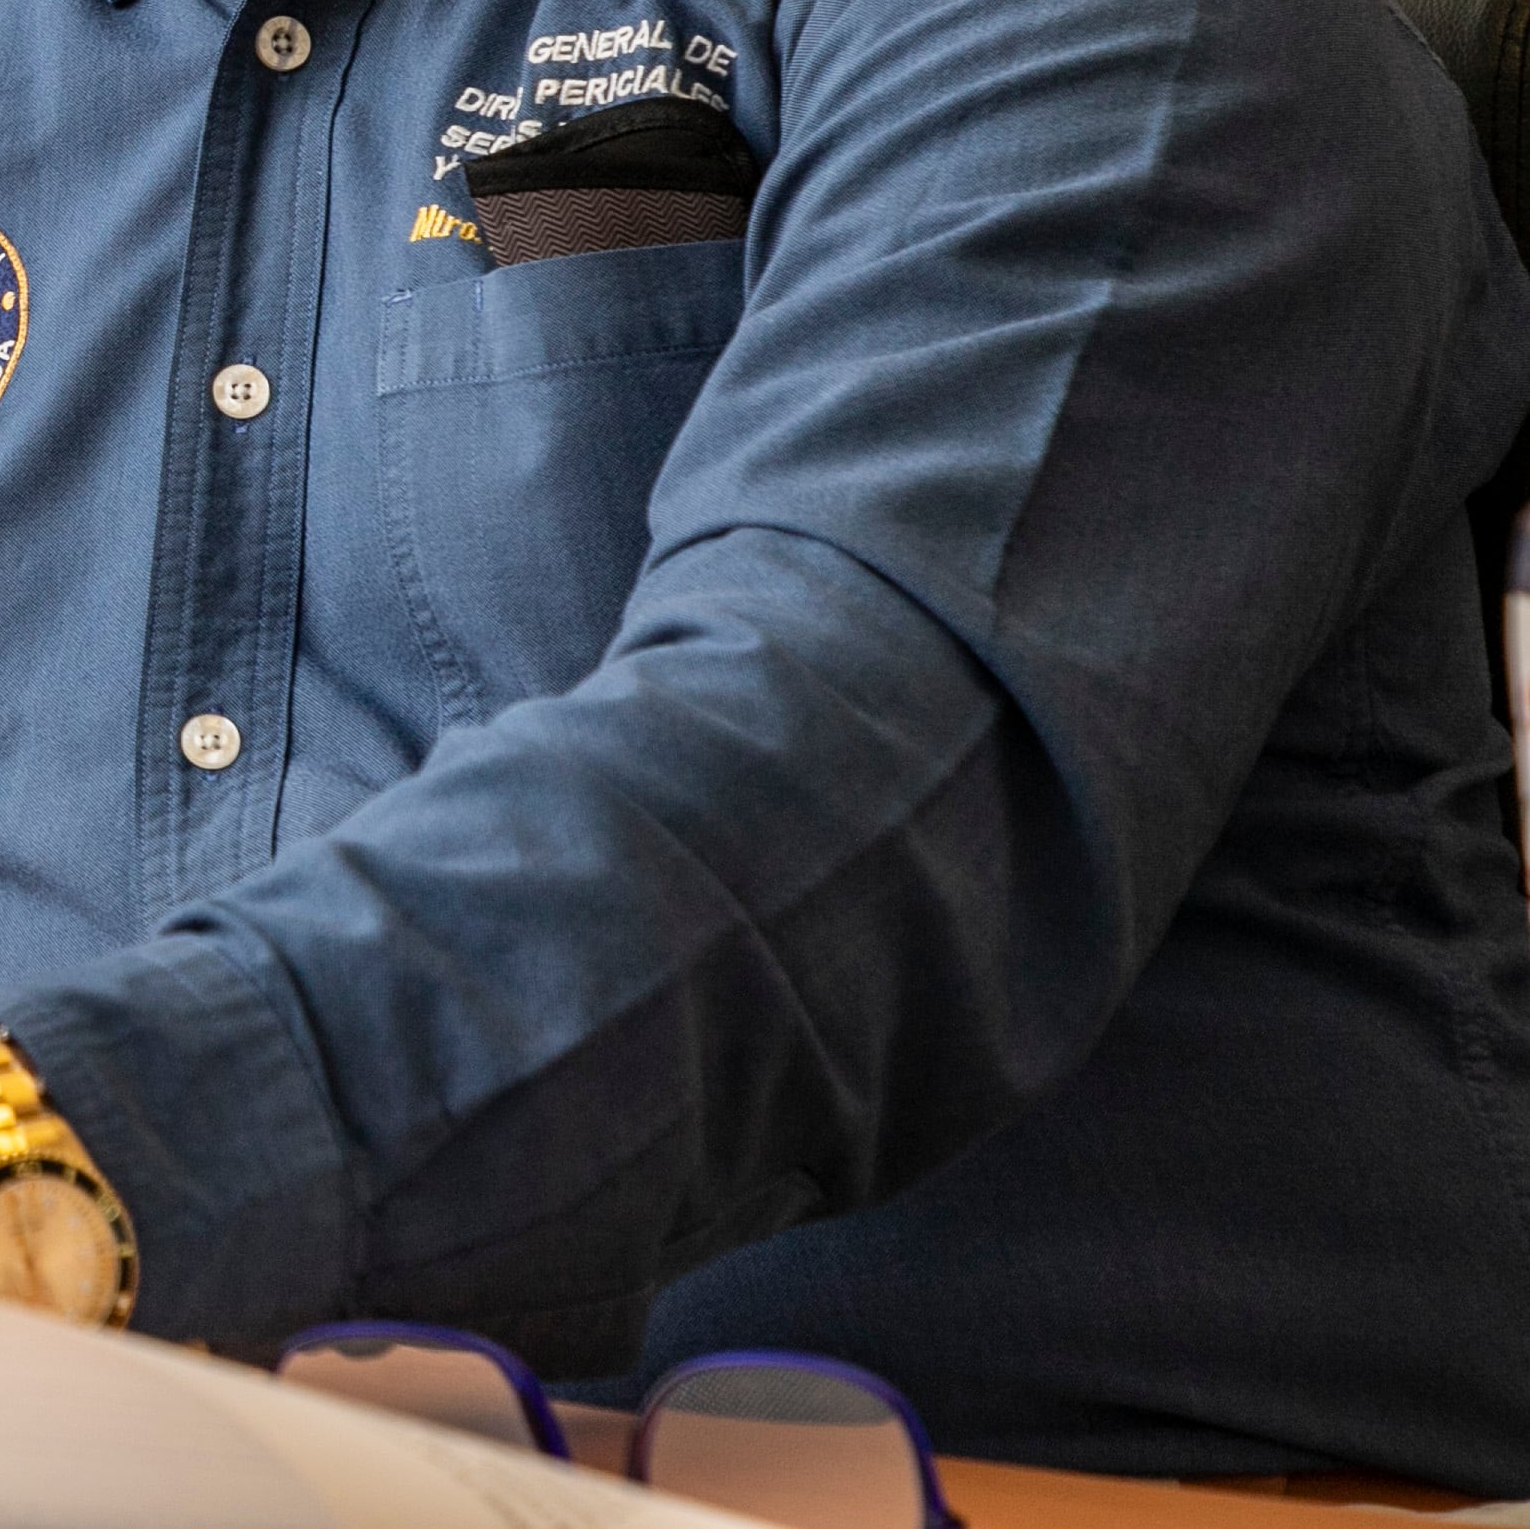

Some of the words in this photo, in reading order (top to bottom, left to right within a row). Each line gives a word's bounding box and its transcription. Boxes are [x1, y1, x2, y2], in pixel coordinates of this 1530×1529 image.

[528, 20, 673, 64] GENERAL
[685, 35, 738, 77] DE
[433, 154, 462, 180] Y
